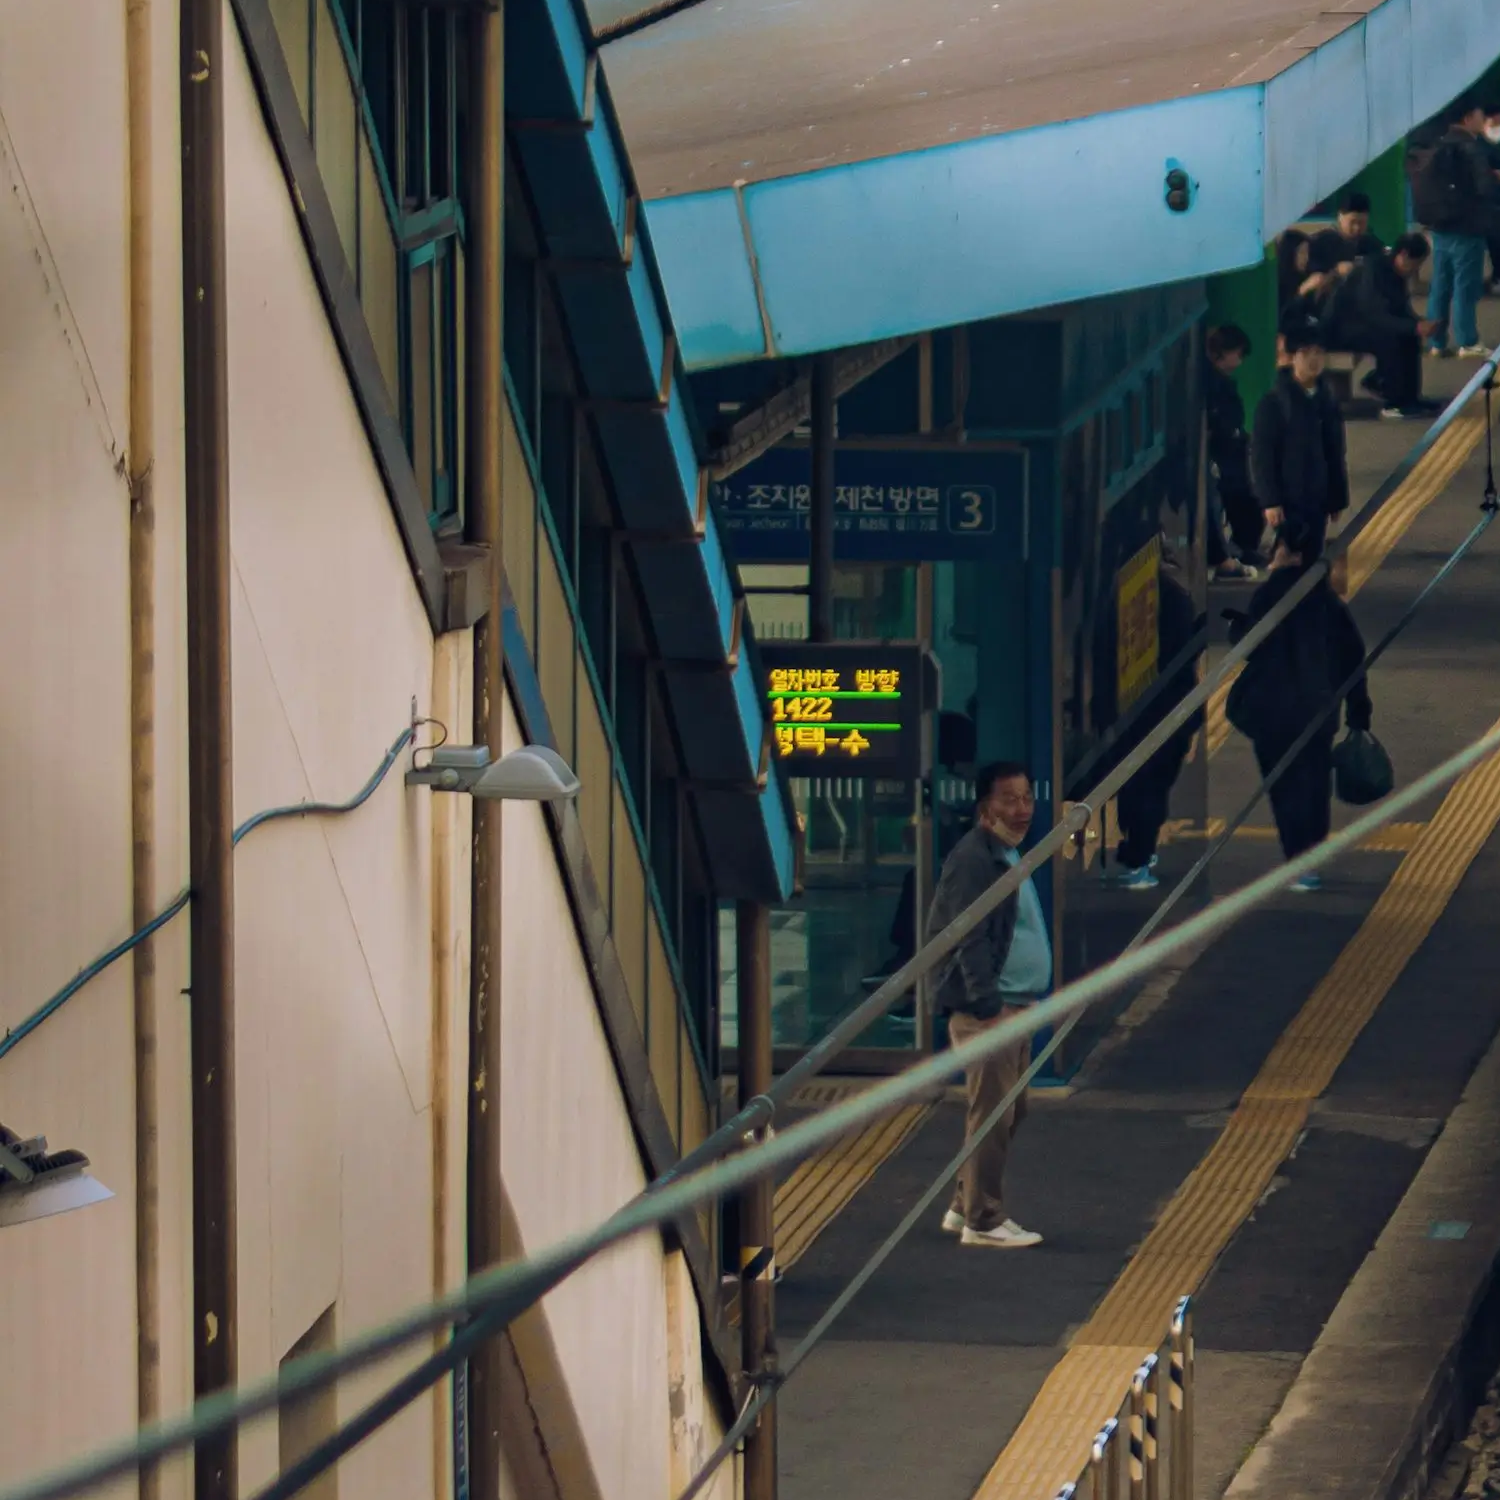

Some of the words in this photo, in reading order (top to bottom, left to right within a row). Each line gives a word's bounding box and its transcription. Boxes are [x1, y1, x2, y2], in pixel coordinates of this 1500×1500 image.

[959, 491, 983, 528] 3
[770, 669, 840, 691] 열차번호
[855, 669, 899, 691] 방향
[773, 697, 833, 721] 1422
